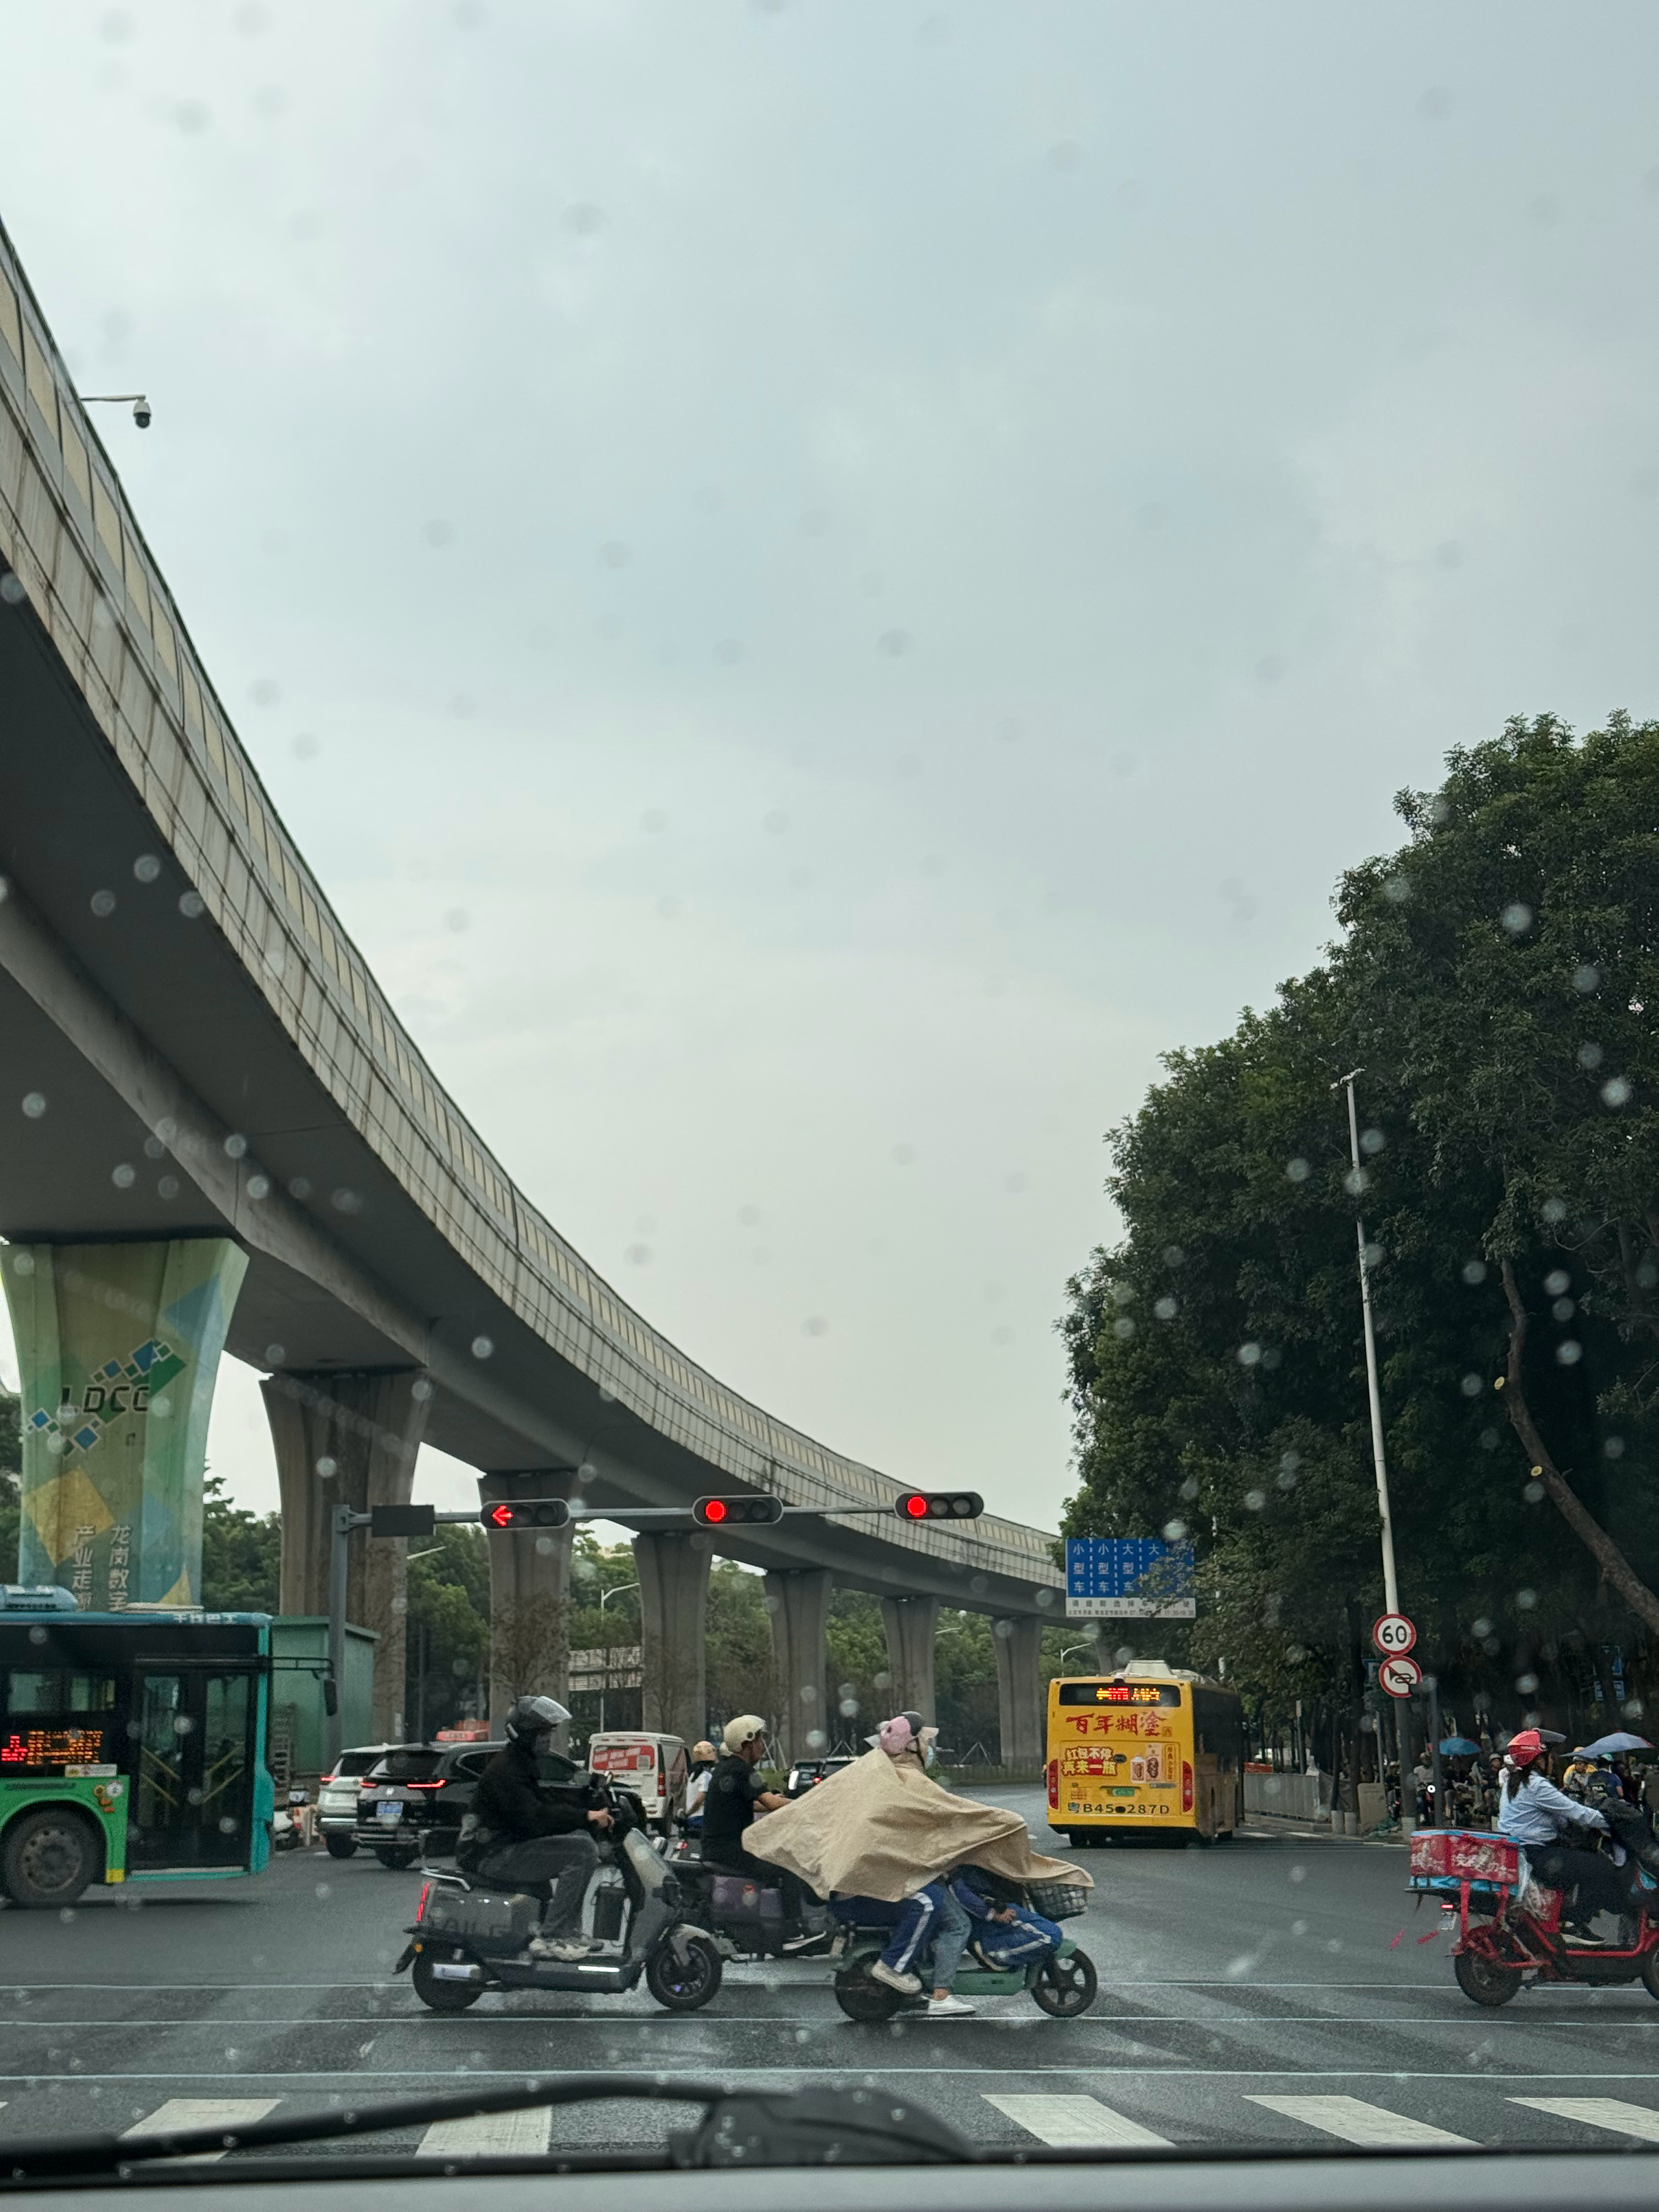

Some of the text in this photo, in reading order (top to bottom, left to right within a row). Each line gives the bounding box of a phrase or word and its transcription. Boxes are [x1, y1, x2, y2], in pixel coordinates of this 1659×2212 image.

[61, 1386, 149, 1413] LDCC
[1073, 1543, 1085, 1593] 小型车
[1098, 1543, 1110, 1593] 小型车
[1122, 1543, 1135, 1592] 大型车
[1383, 1626, 1407, 1644] 60
[1066, 1748, 1113, 1760] 红包不停
[1063, 1761, 1116, 1776] 再来一瓶
